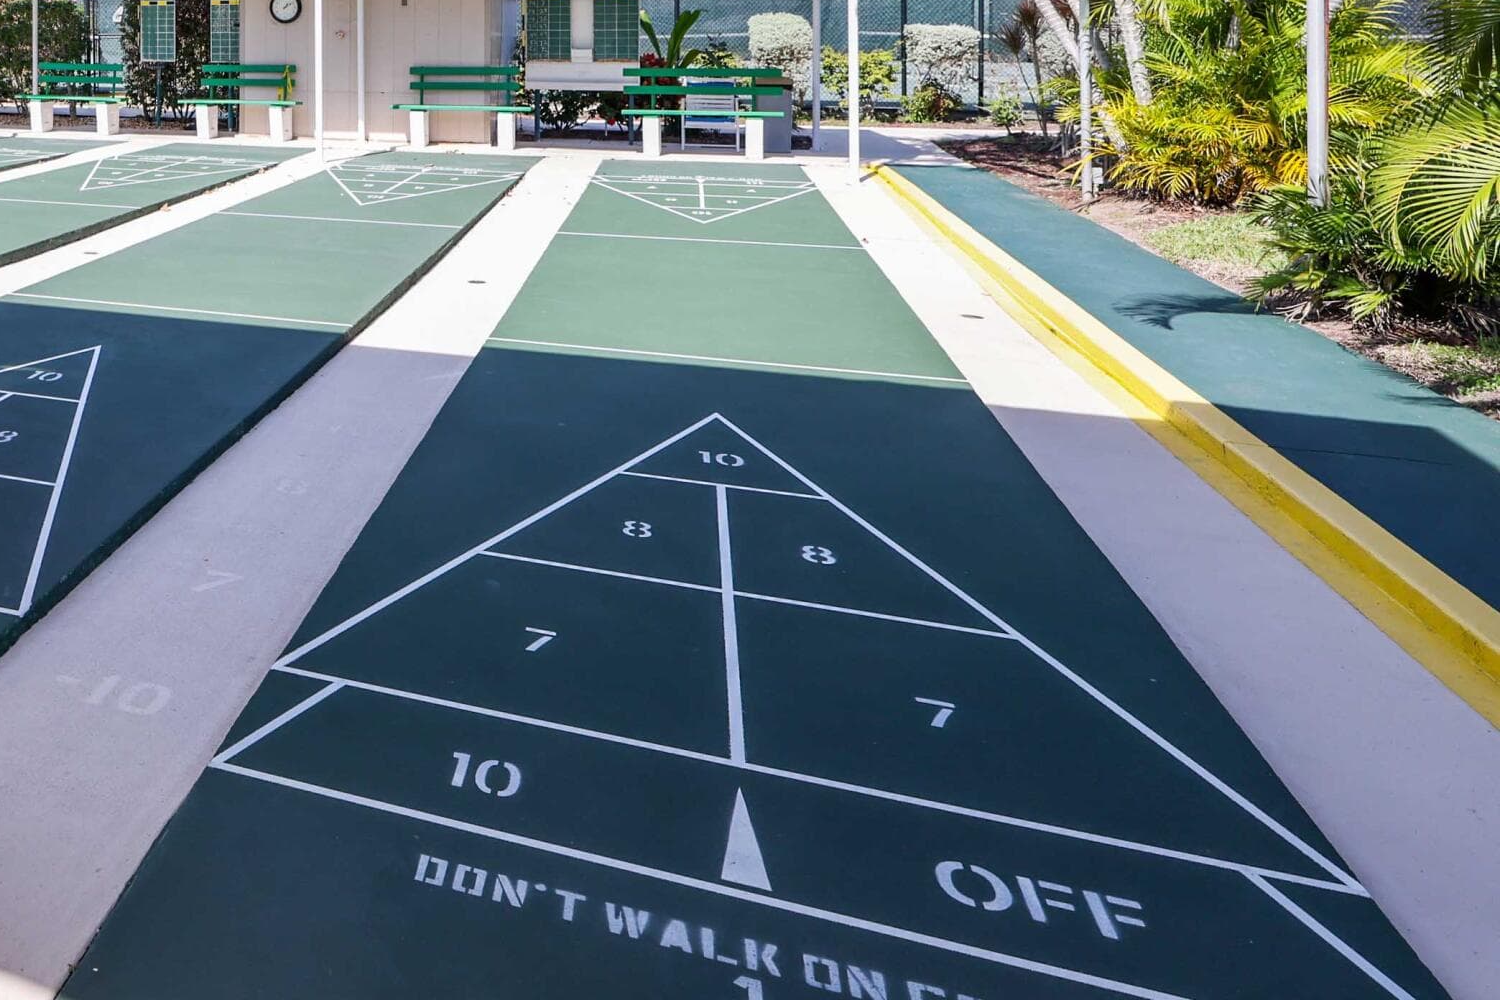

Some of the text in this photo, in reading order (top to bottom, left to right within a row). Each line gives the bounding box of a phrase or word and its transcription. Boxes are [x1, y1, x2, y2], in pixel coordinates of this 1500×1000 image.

[28, 370, 62, 381] 10
[699, 451, 744, 466] 10
[623, 521, 651, 537] 8
[802, 546, 836, 564] 8
[526, 627, 556, 651] 7
[915, 697, 955, 727] 7
[452, 752, 521, 796] 10
[934, 861, 1146, 941] OFF
[414, 853, 888, 1000] DON'T WALK ON
